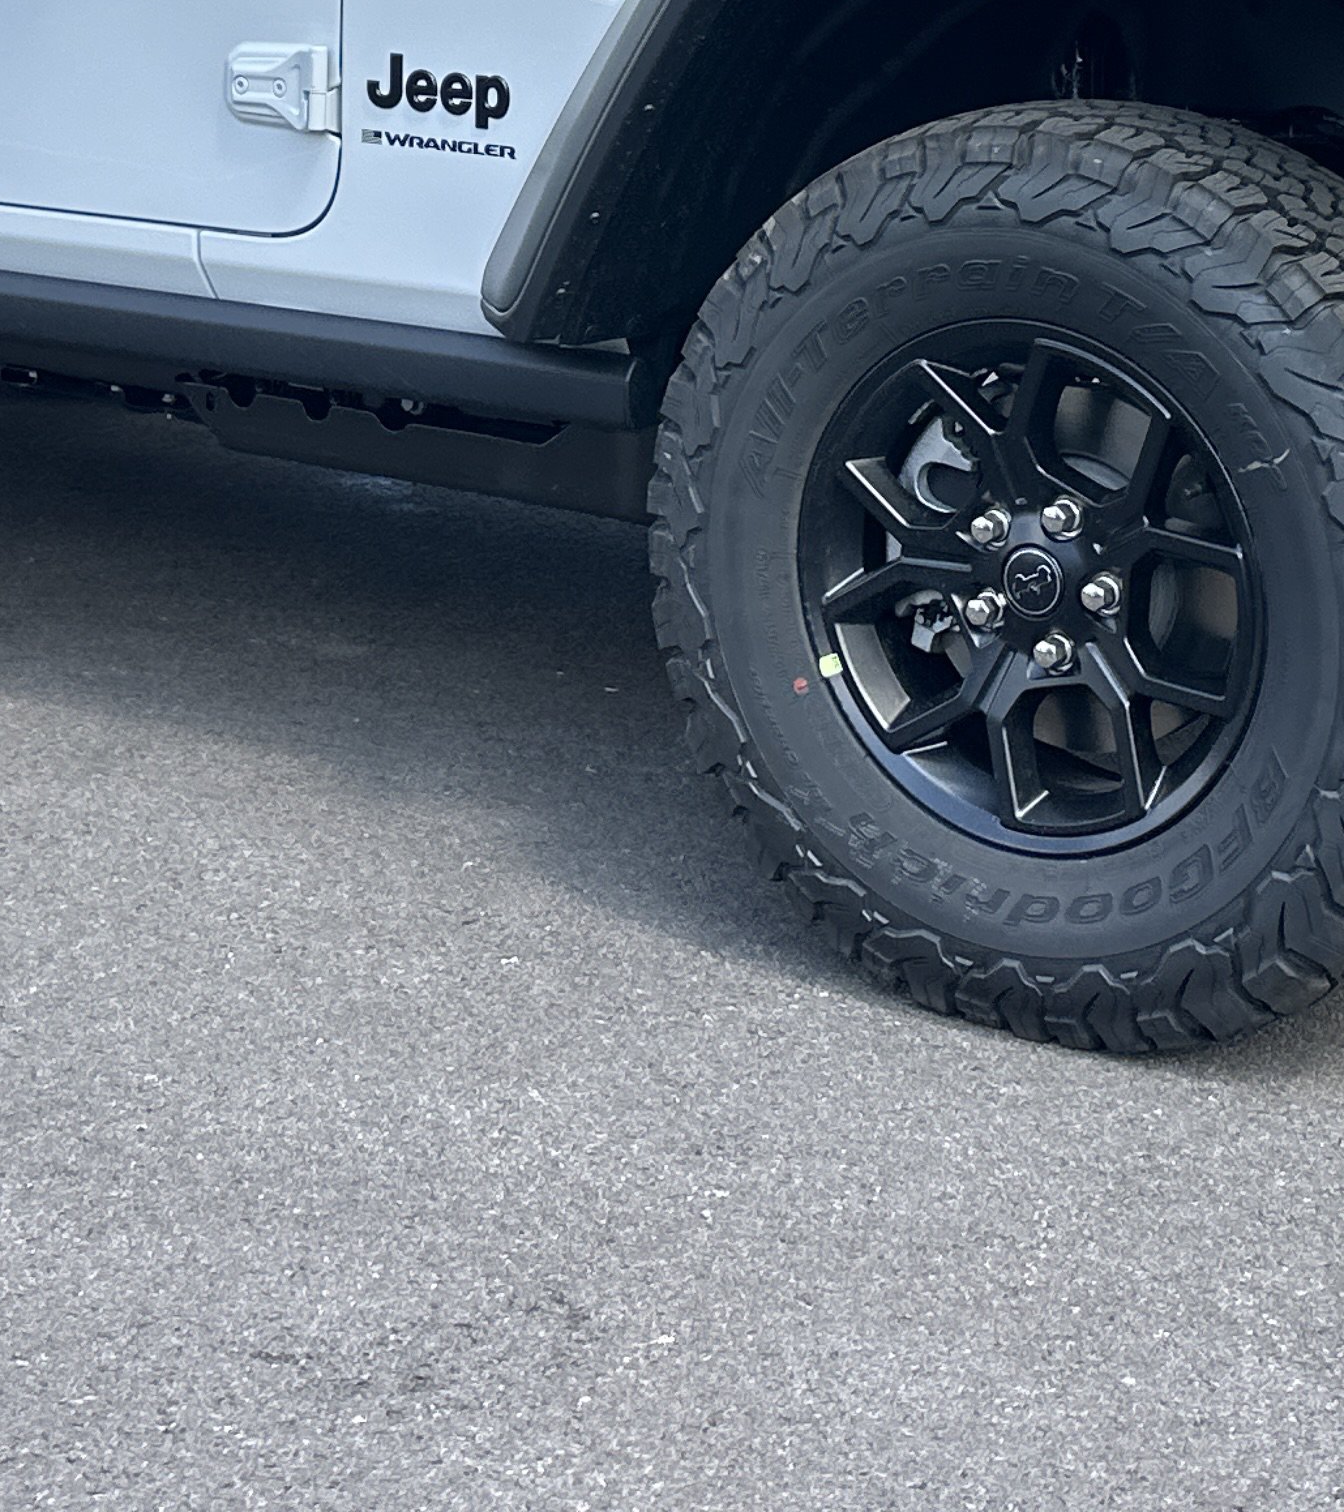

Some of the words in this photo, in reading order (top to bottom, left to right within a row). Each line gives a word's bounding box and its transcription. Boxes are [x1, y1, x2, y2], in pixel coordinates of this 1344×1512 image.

[366, 52, 511, 130] Jeep
[384, 131, 517, 160] WRANGLER
[1099, 281, 1223, 401] T/A
[846, 743, 1290, 926] BFGoodrich
